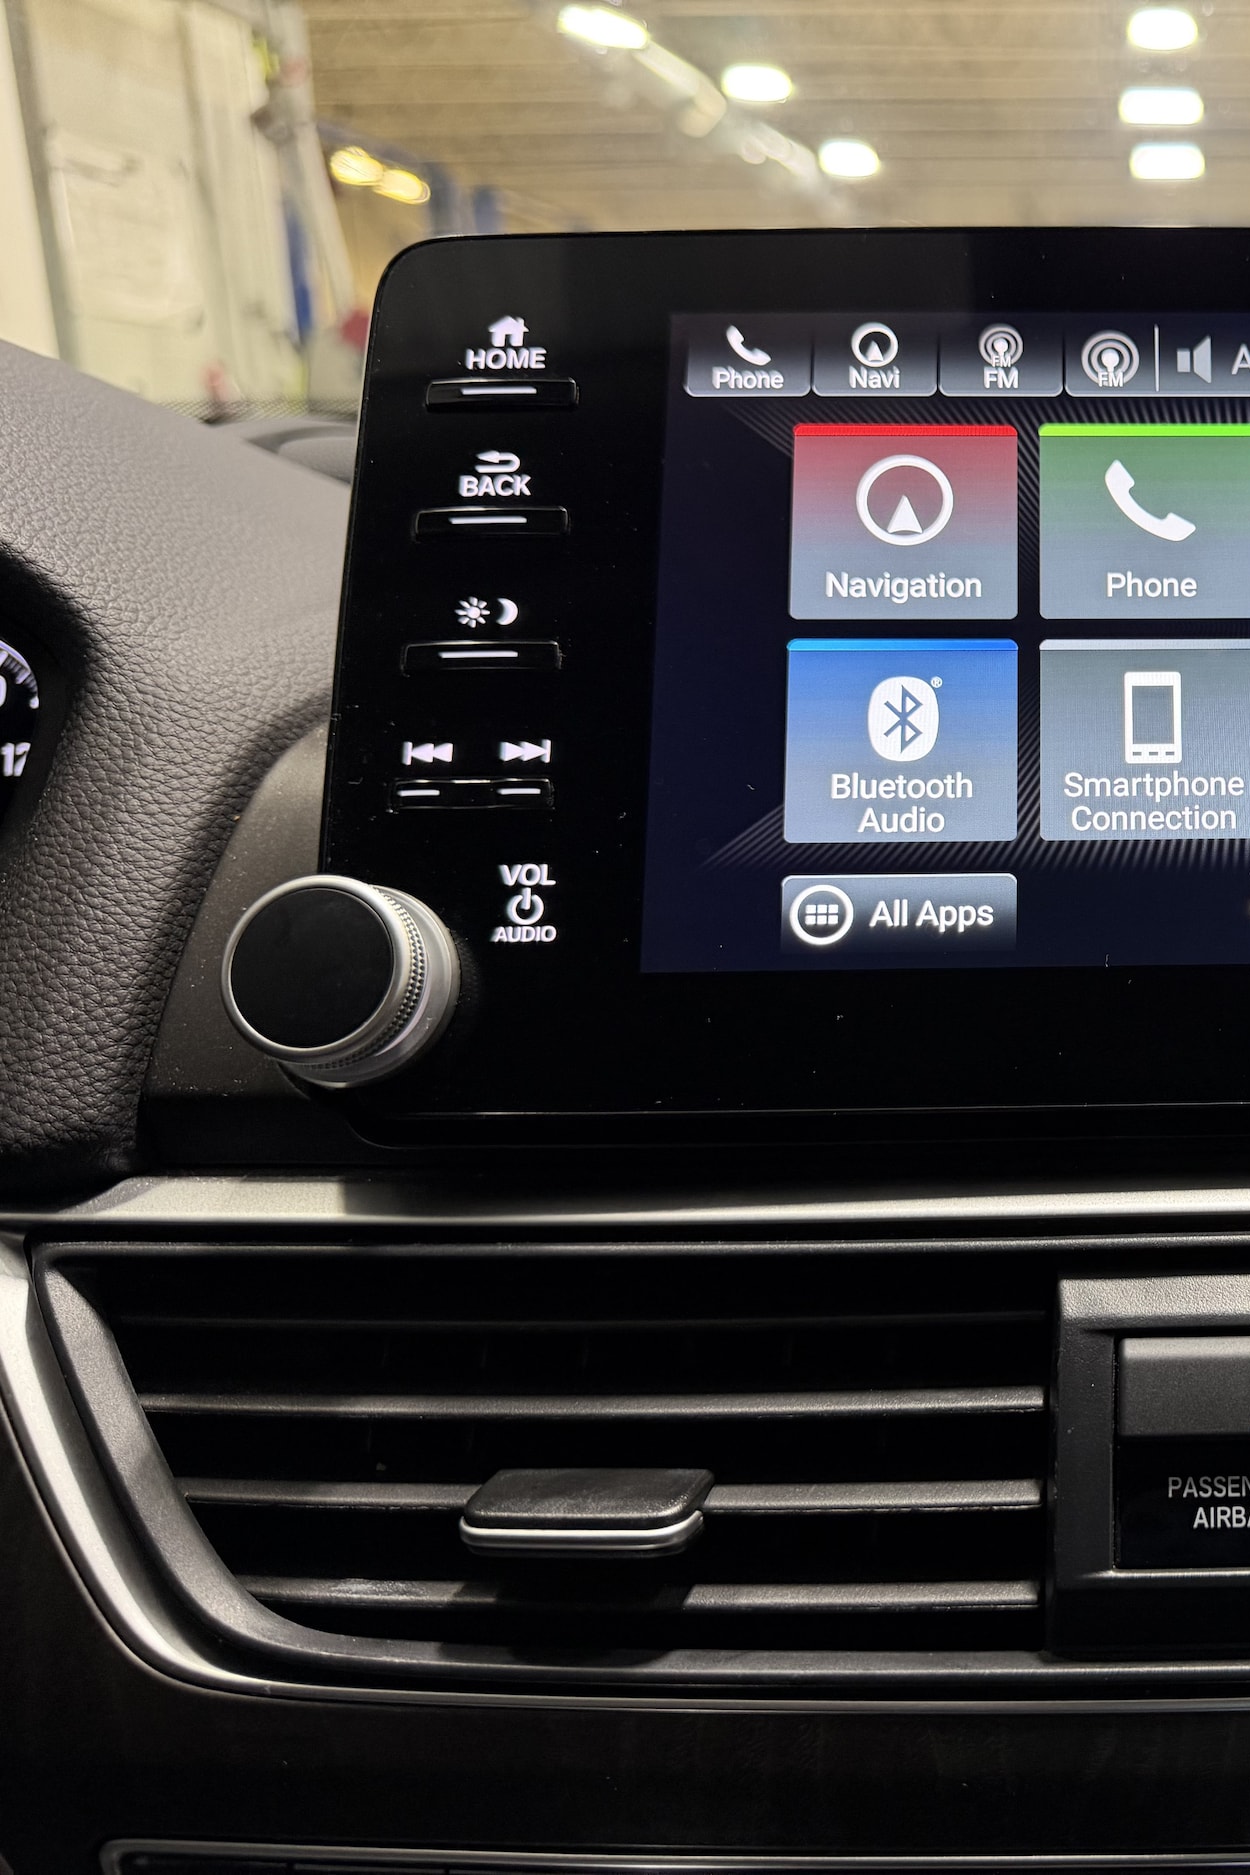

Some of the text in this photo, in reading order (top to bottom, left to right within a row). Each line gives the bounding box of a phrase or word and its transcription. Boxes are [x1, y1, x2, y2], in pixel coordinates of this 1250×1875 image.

[465, 347, 546, 370] HOME
[712, 366, 784, 390] Phone
[849, 366, 901, 389] Navi
[983, 368, 1019, 389] FM
[1097, 372, 1124, 388] FM
[459, 474, 531, 497] BACK
[825, 571, 982, 604] Navigation
[1106, 571, 1197, 598] Phone
[830, 771, 973, 800] Bluetooth
[1064, 771, 1245, 803] Smartphone
[857, 807, 945, 833] Audio
[1071, 804, 1237, 832] Connection
[498, 863, 556, 887] VOL
[868, 899, 995, 932] All Apps
[490, 925, 557, 943] AUDIO
